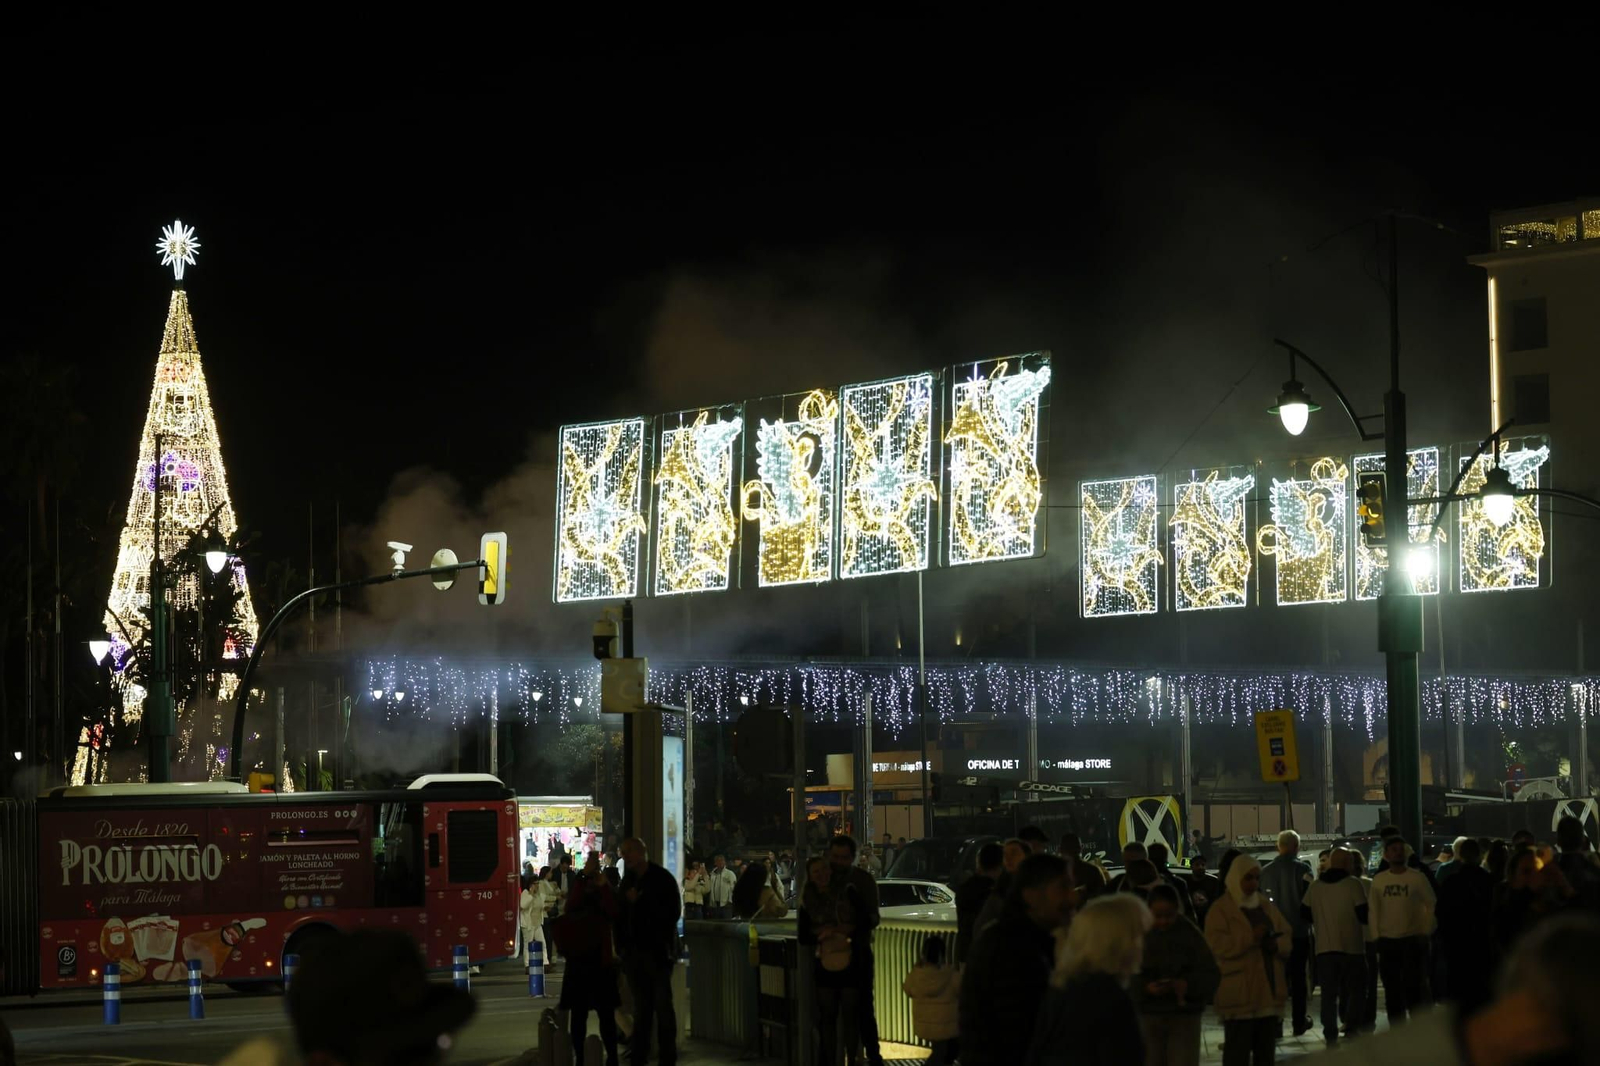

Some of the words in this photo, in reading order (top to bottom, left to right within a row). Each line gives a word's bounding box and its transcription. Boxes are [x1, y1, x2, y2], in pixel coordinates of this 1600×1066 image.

[968, 760, 1000, 769] OFICINA
[1002, 760, 1013, 769] DE
[1057, 759, 1083, 770] málaga
[1085, 758, 1111, 768] STORE
[270, 810, 329, 819] PROLONGO.ES
[95, 819, 148, 838] Desde
[154, 823, 189, 836] 1820
[293, 853, 320, 861] PALETA
[333, 852, 360, 860] HORNO
[58, 839, 223, 886] PROLONGO
[288, 861, 334, 869] LONCHEADO
[100, 896, 130, 907] para
[135, 889, 182, 907] Málaga
[477, 891, 493, 900] 740
